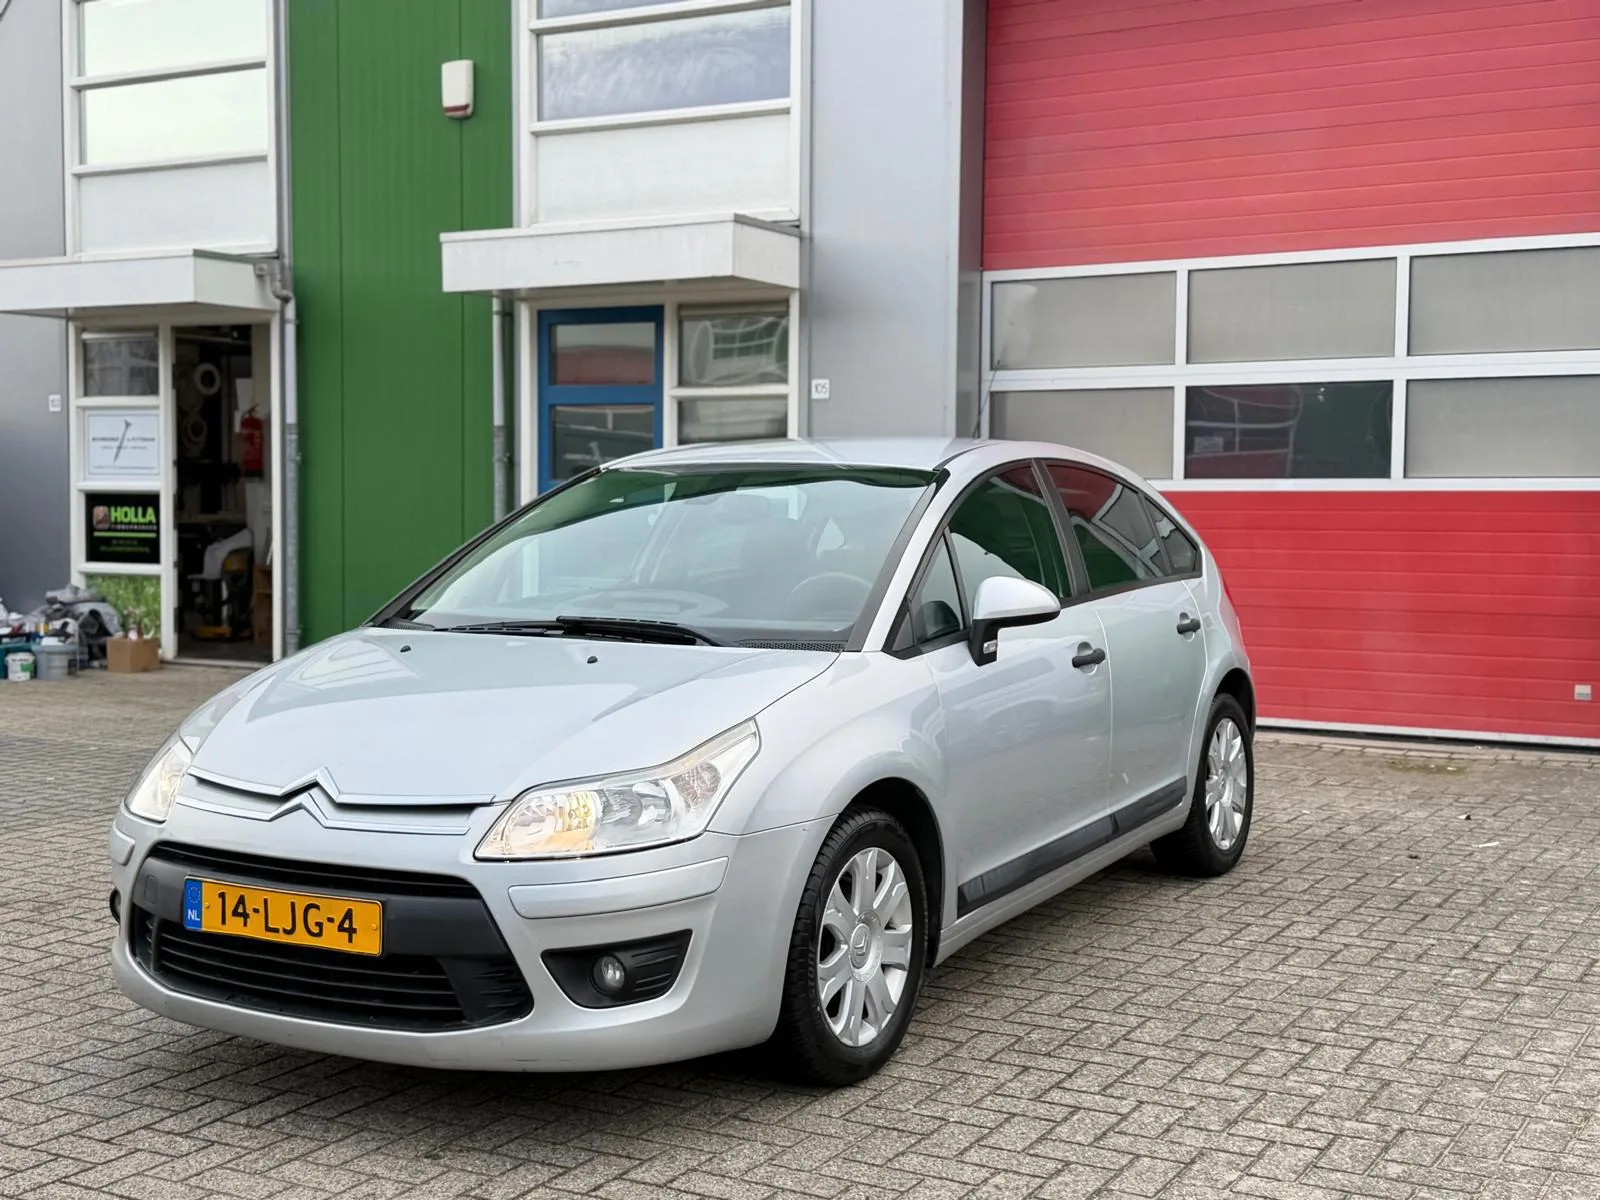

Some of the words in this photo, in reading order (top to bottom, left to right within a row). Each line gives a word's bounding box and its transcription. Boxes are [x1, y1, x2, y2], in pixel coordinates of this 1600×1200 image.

[110, 506, 156, 523] HOLLA
[187, 908, 200, 921] NL
[218, 891, 357, 943] 14-LJG-4
